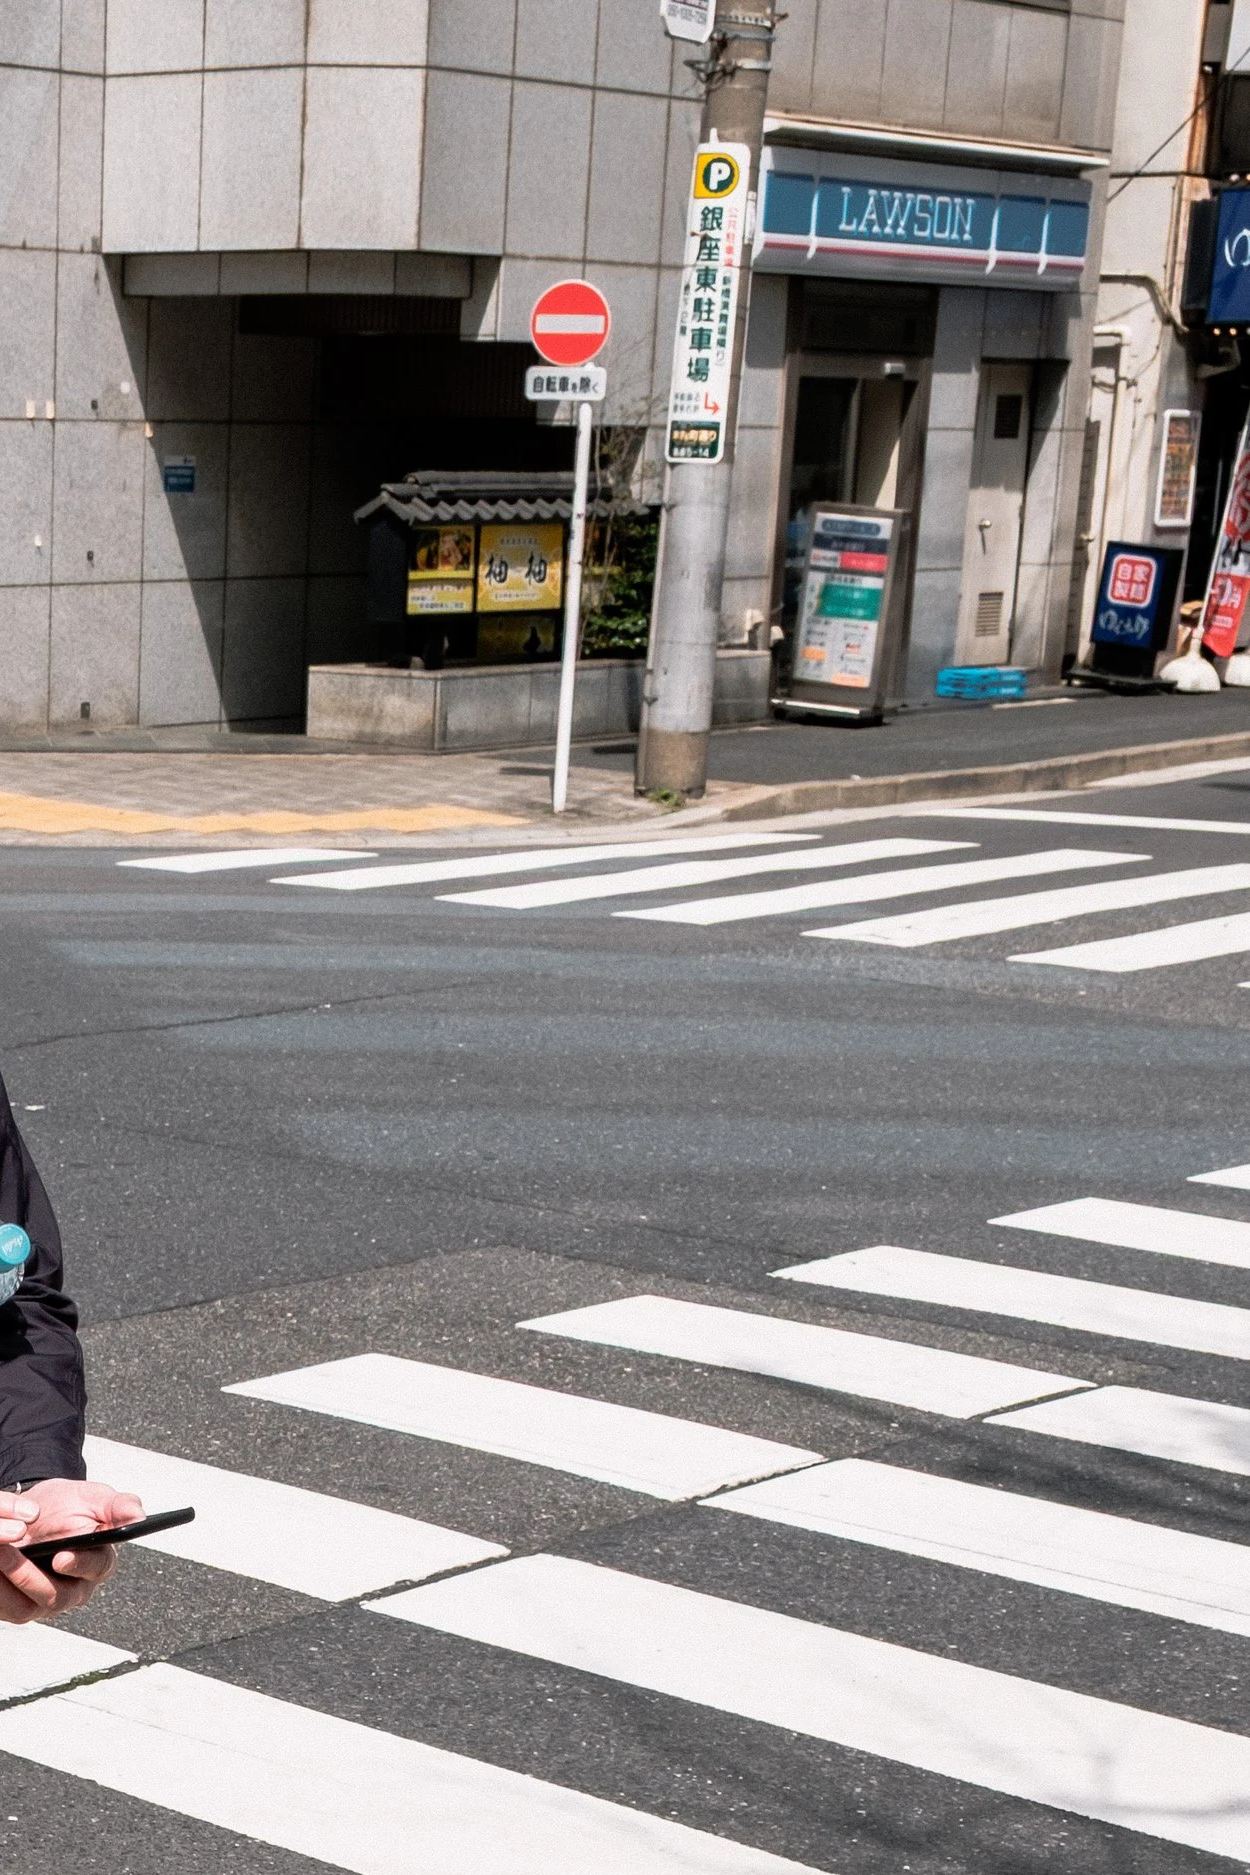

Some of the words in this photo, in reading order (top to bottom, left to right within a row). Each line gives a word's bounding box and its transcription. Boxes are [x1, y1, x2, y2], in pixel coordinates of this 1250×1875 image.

[709, 162, 731, 191] P
[838, 186, 976, 241] LAWSON
[686, 206, 724, 383] 銀座東駐車場
